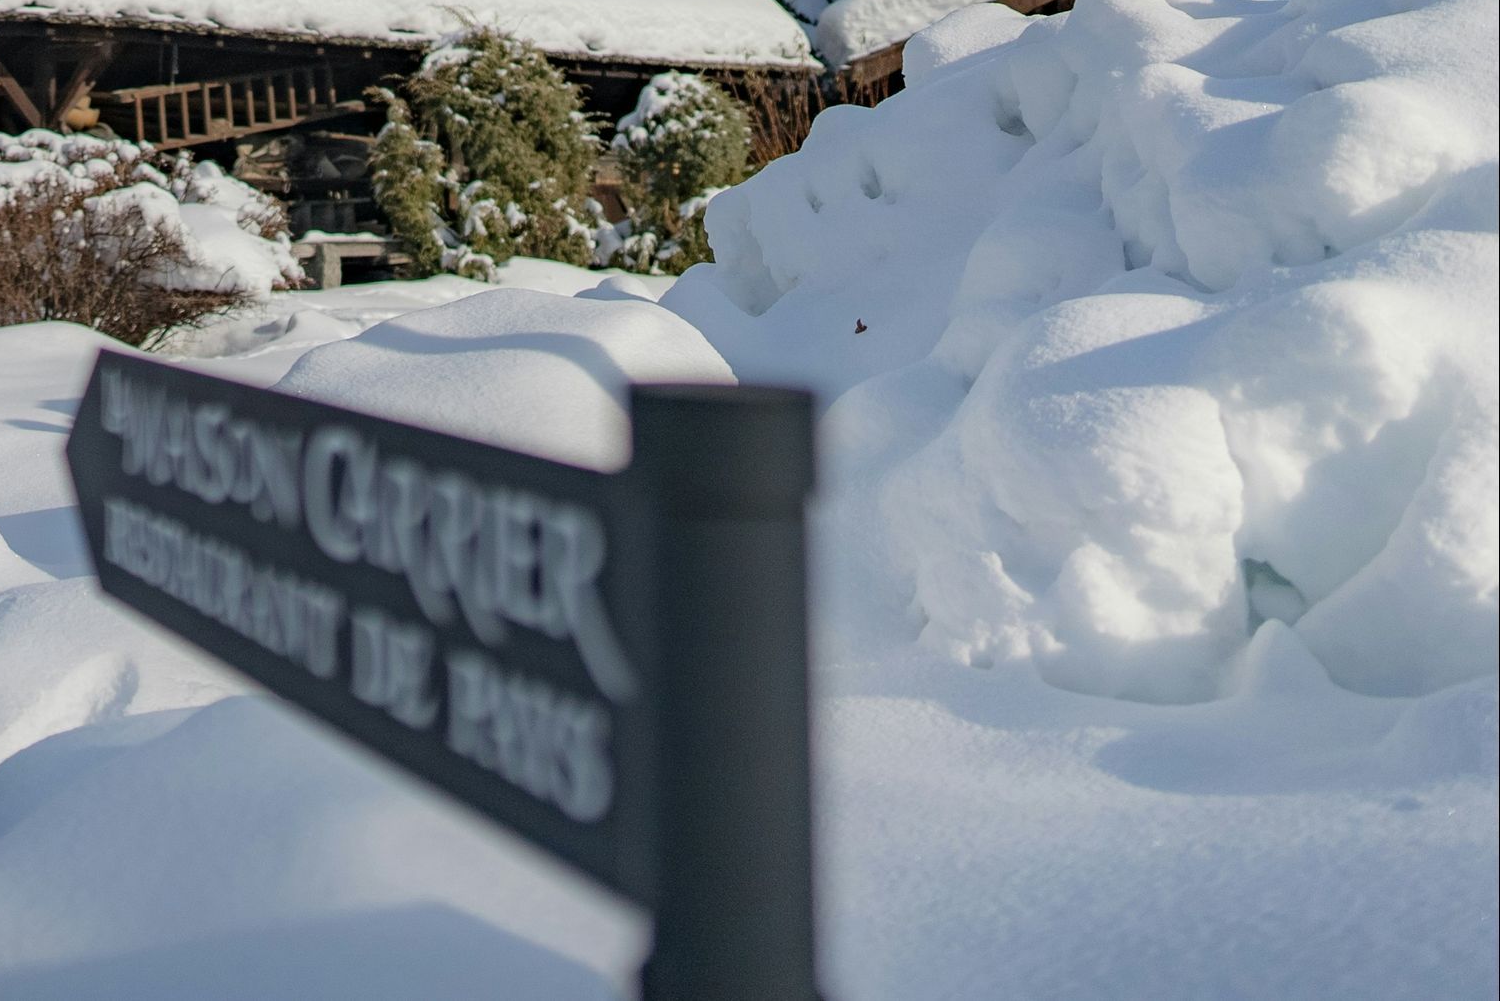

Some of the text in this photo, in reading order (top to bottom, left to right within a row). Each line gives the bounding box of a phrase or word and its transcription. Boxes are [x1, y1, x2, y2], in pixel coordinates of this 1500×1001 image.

[102, 497, 614, 824] RESTAURANT DE PAYS
[304, 428, 640, 701] CARRIER
